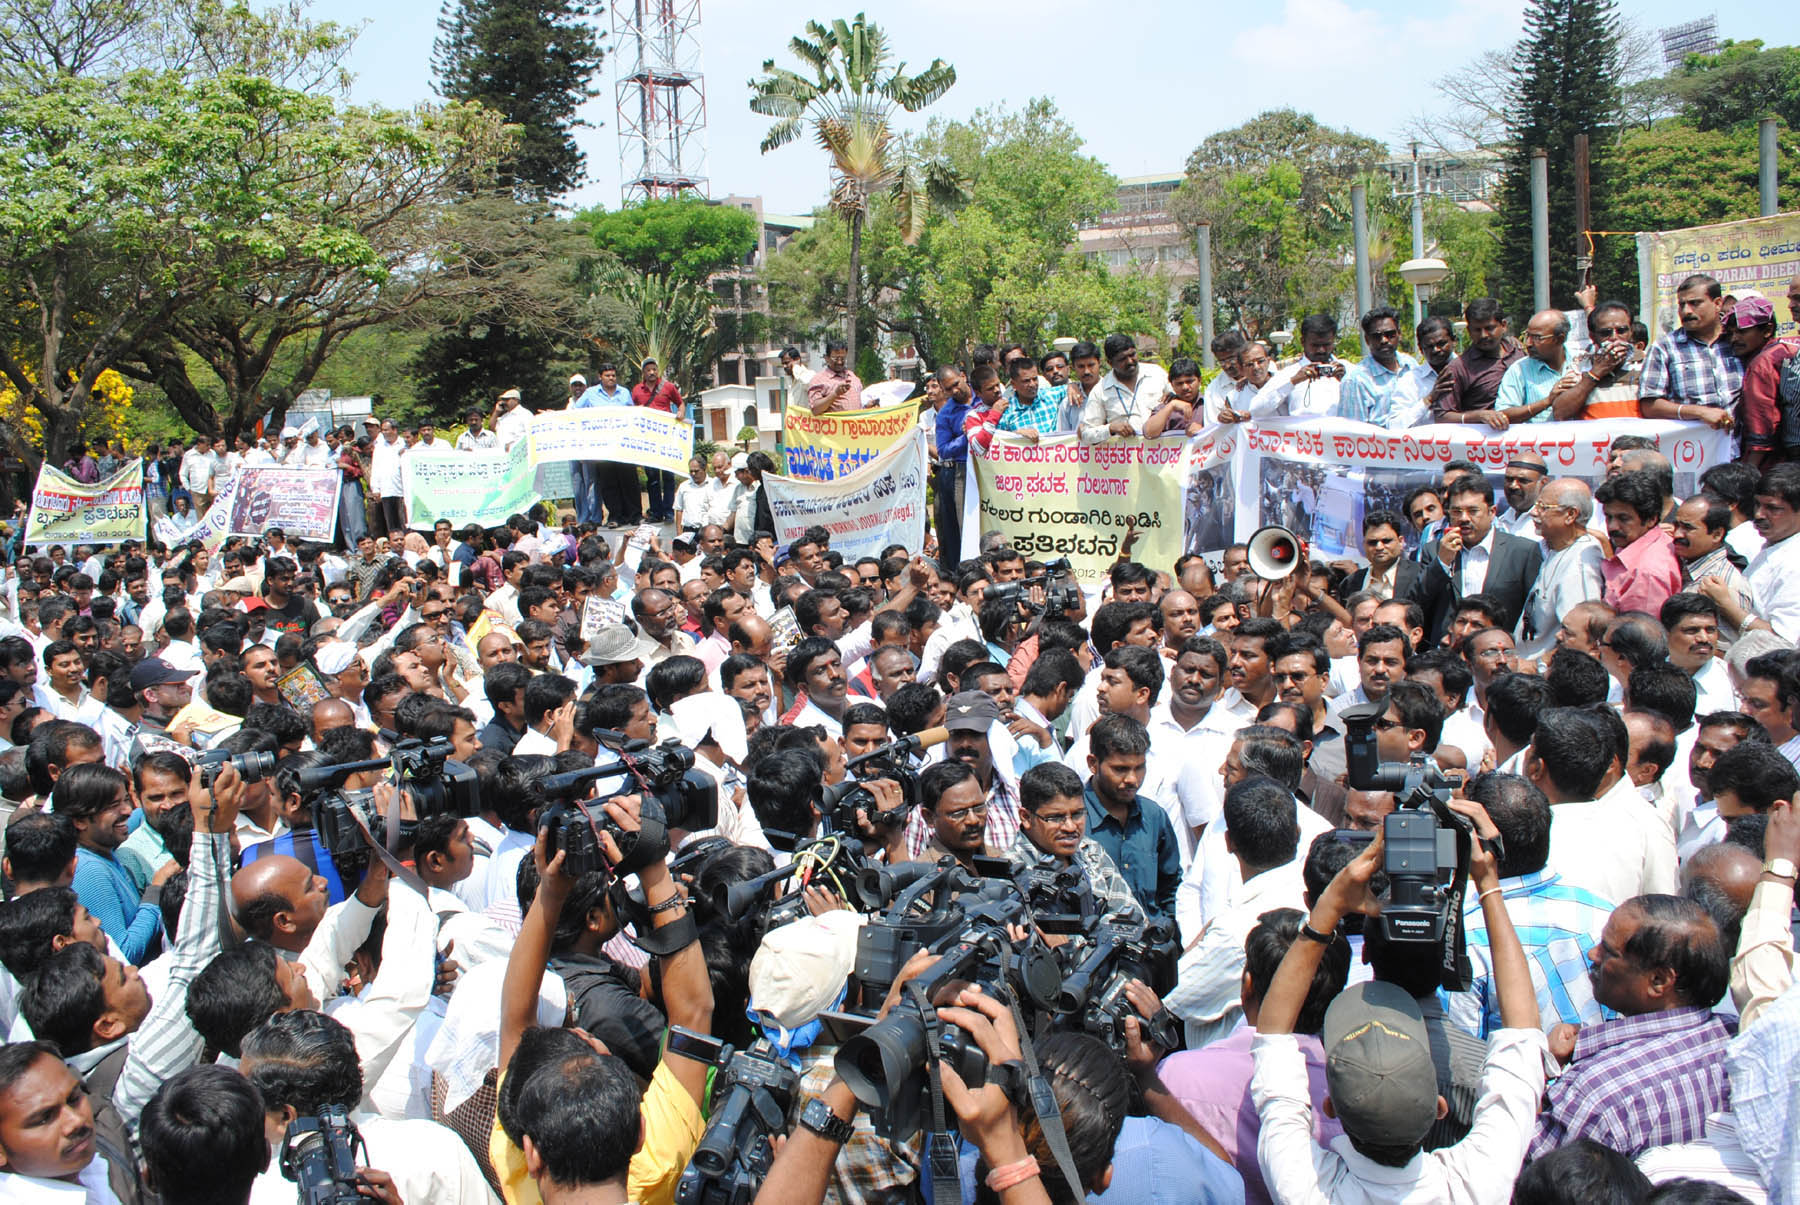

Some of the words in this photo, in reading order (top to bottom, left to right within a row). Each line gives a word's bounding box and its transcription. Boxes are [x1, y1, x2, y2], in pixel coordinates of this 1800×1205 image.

[1715, 266, 1758, 283] PARAM
[1003, 442, 1090, 464] ಕಾರ್ಯನಿರತ
[1146, 442, 1183, 469] ಸಂಘ
[1248, 424, 1324, 457] ಕರ್ನಾಟಕ
[1332, 432, 1452, 463] ಕಾರ್ಯನಿರತ
[1465, 434, 1575, 470] ಪತ್ರಕರ್ತರ
[1673, 439, 1705, 469] (ರಿ)
[995, 474, 1023, 500] ಜಿಲ್ಲಾ
[1076, 472, 1130, 496] ಗುಲಬರ್ಗಾ
[84, 504, 140, 525] ಪ್ರತಿಭಟನೆ
[1028, 508, 1112, 526] ಗುಂಡಾಗಿರಿ
[1115, 511, 1162, 528] ಖಂಡಿಸಿ
[1013, 532, 1118, 557] ಪ್ರತಿಭಟನೆ
[1395, 919, 1431, 928] Panasonic
[1443, 890, 1461, 972] Panasonic
